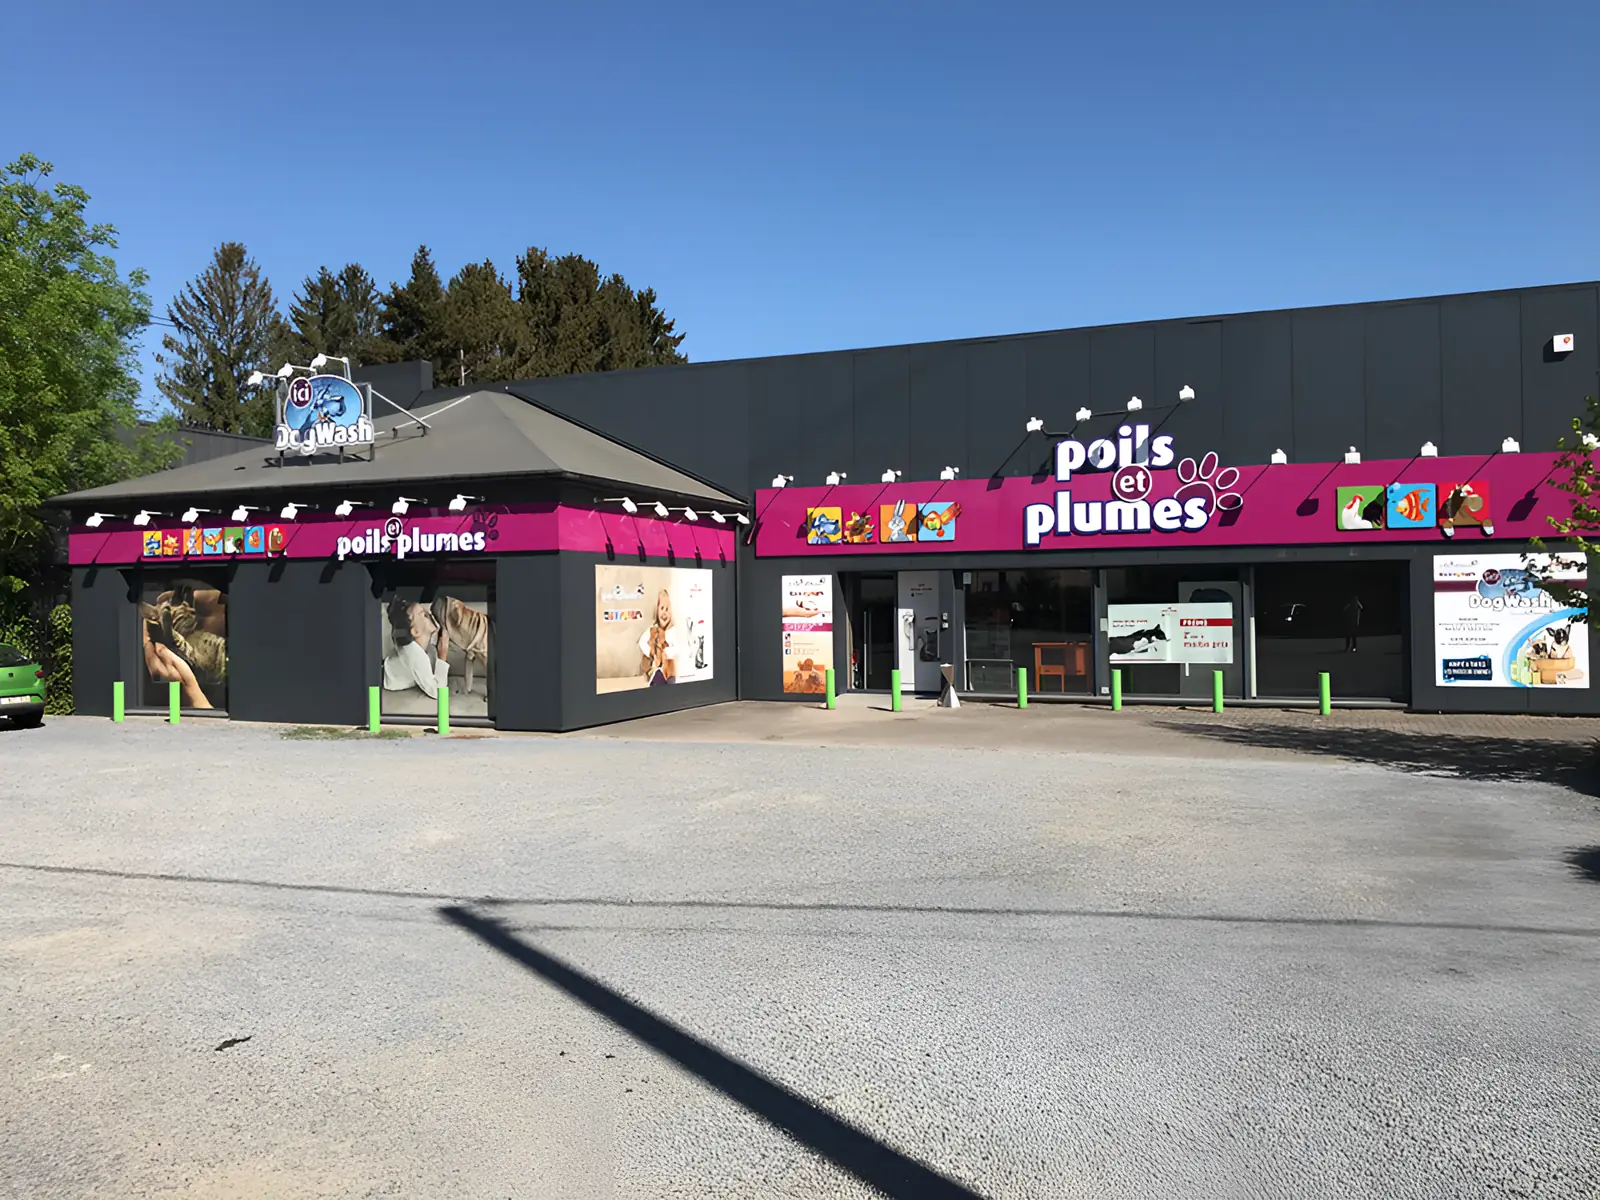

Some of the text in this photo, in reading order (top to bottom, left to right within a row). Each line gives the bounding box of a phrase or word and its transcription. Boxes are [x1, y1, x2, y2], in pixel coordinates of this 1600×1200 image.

[293, 383, 310, 403] ici
[275, 418, 373, 450] DogWash
[1055, 424, 1175, 483] poils
[1119, 470, 1147, 493] et
[1024, 490, 1209, 545] plumes
[337, 528, 391, 561] poils
[397, 527, 486, 560] plumes
[1468, 590, 1550, 612] DogWash
